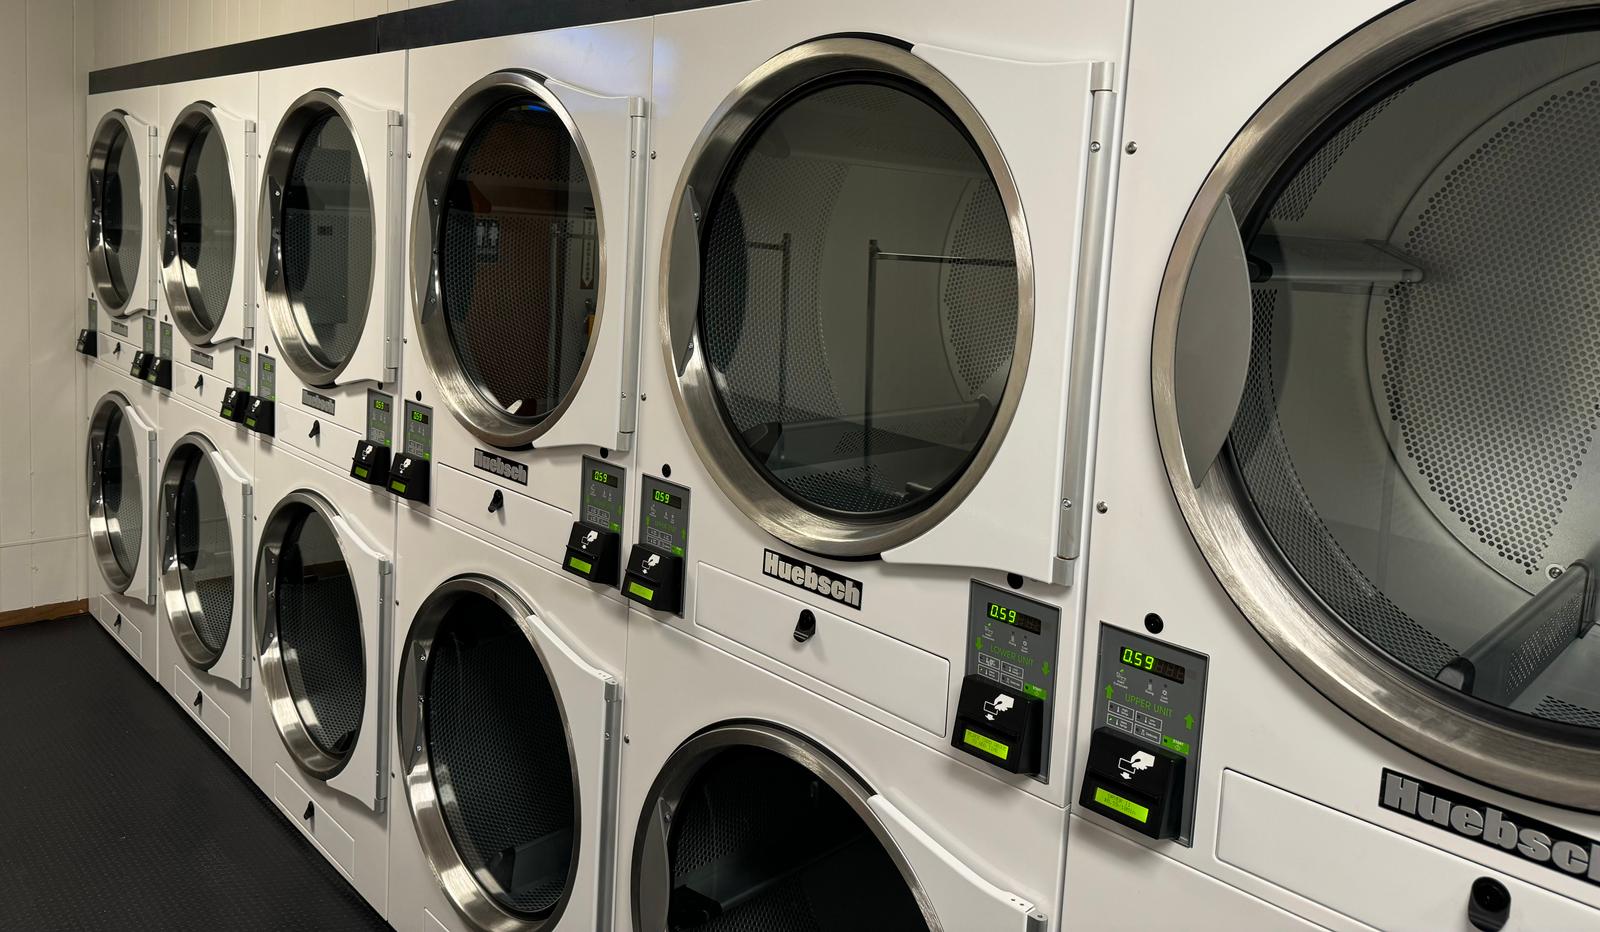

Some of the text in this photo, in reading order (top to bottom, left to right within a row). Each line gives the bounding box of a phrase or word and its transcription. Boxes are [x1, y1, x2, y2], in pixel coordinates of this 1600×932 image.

[474, 449, 528, 484] Huebsch
[764, 551, 861, 607] Huebsch
[990, 604, 1017, 623] 0.59
[990, 644, 1016, 659] LOWER
[1017, 654, 1034, 667] UNIT
[1122, 648, 1155, 670] 0.59
[1125, 693, 1152, 710] UPPER
[1153, 704, 1173, 717] UNIT
